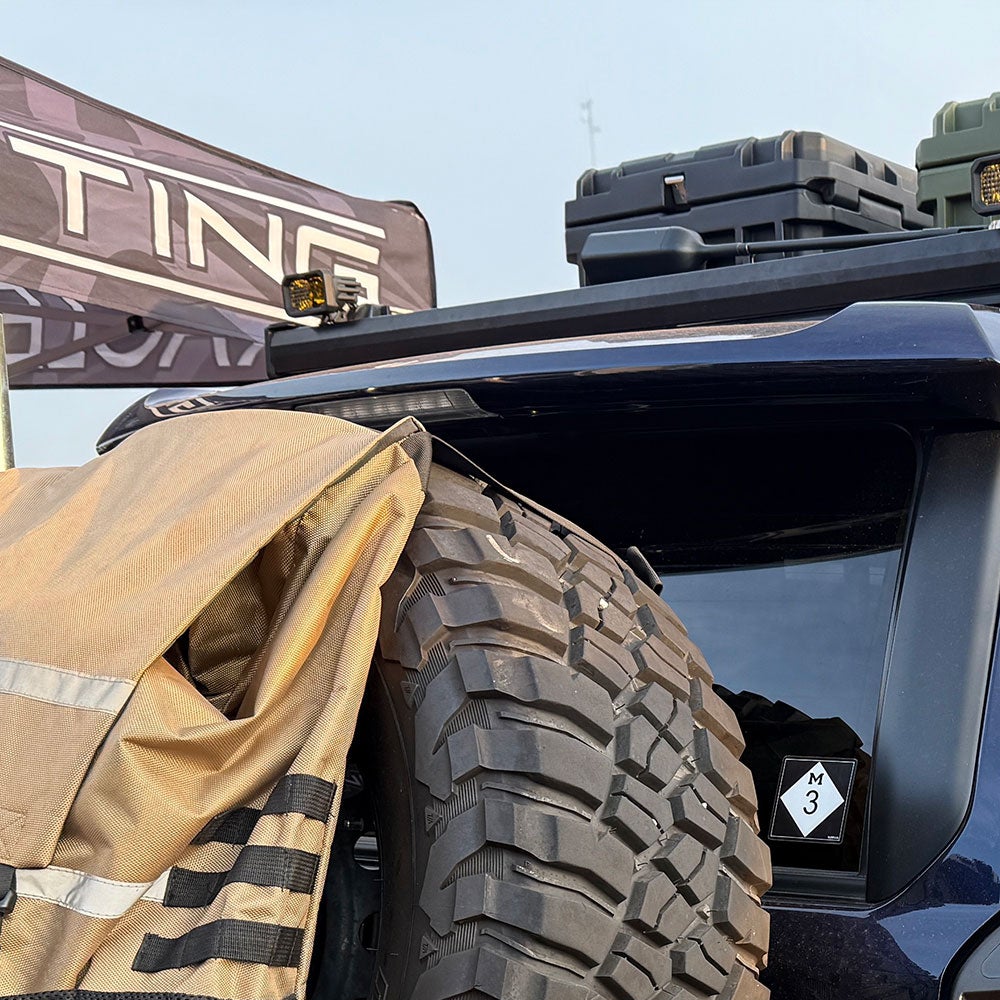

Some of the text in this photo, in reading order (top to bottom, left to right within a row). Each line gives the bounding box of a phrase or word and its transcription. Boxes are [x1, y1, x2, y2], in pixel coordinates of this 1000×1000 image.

[8, 133, 382, 305] TING
[808, 772, 824, 785] M
[803, 789, 819, 815] 3
